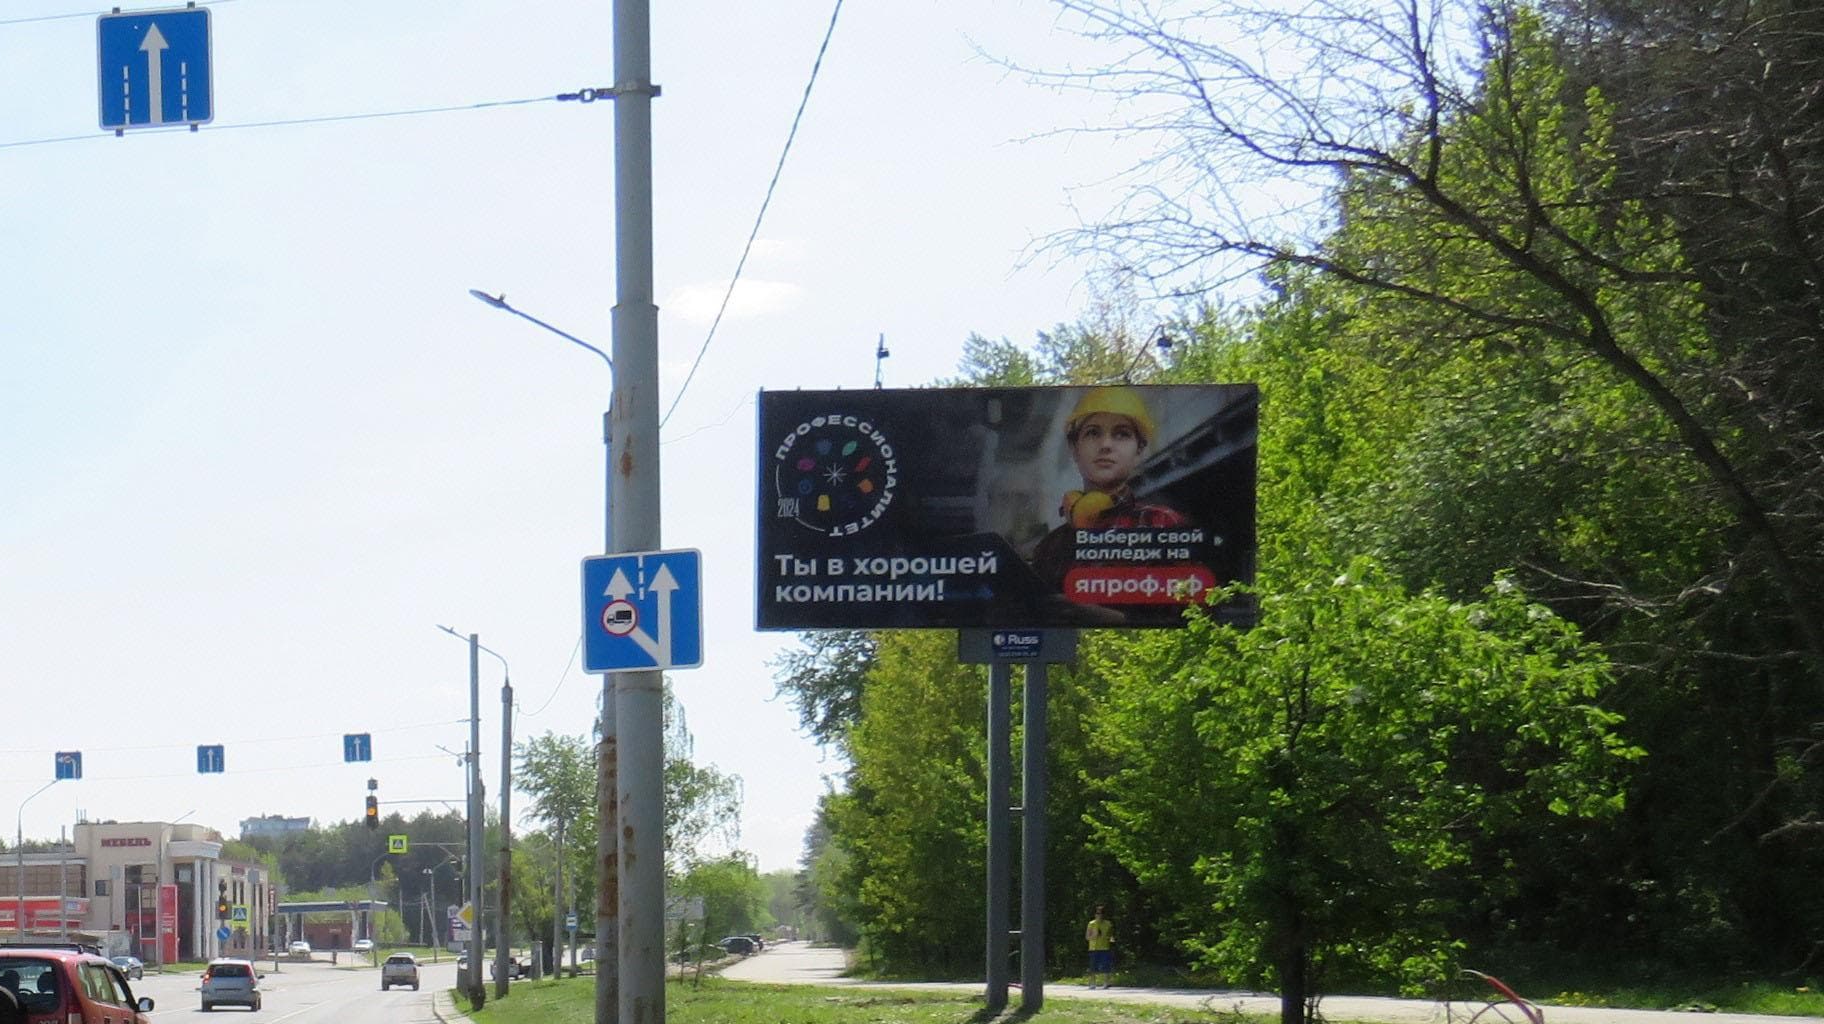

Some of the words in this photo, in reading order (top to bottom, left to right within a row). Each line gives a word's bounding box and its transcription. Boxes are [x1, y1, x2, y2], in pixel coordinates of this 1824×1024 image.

[776, 415, 897, 536] ПРОФЕССИОНАЛИТЕТ
[777, 497, 799, 517] 2024
[1076, 530, 1152, 546] Выбери
[1157, 529, 1203, 543] свой
[775, 554, 816, 576] Ты
[827, 558, 844, 576] в
[853, 551, 997, 580] хорошей
[1076, 549, 1161, 561] колледж
[1167, 549, 1189, 559] на
[776, 579, 944, 602] компании!
[1076, 574, 1203, 597] япроф.рф
[1008, 634, 1038, 644] Russ
